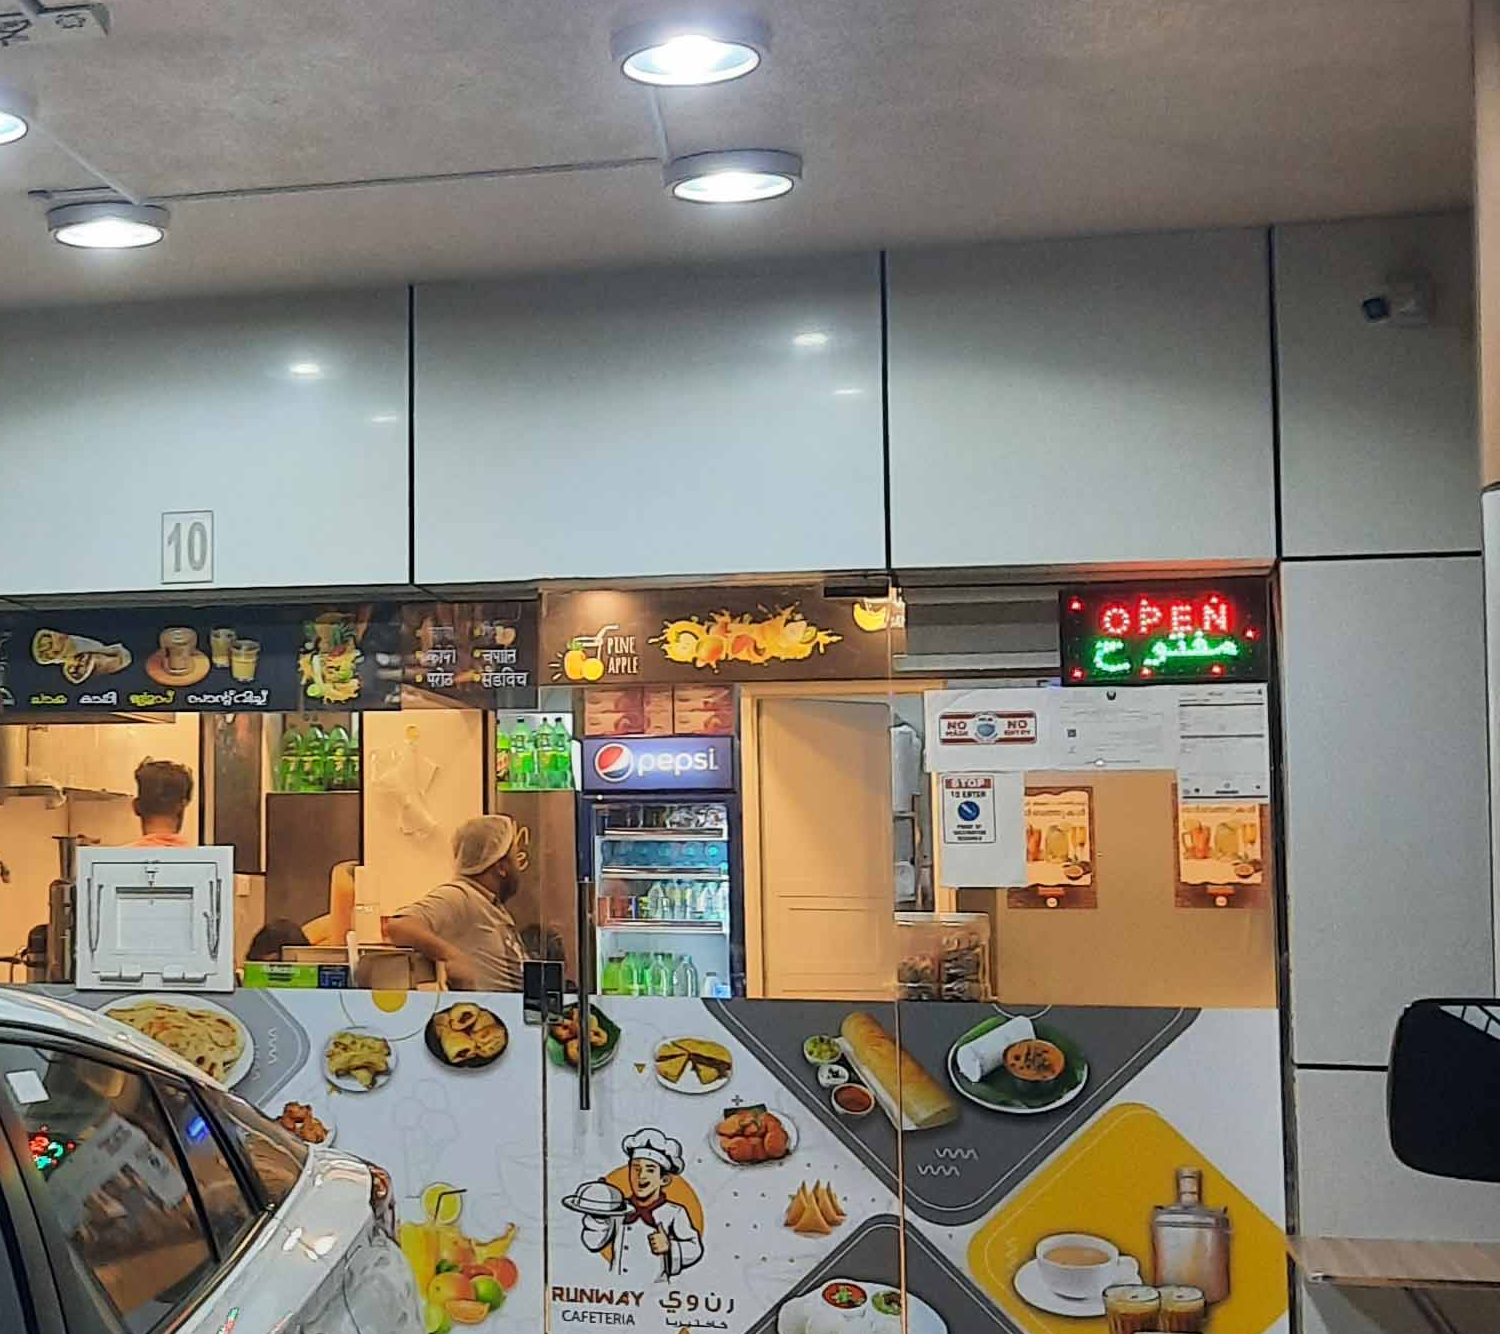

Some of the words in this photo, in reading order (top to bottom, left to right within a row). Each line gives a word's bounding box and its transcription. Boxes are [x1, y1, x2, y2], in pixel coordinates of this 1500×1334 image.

[167, 521, 208, 573] 10
[1103, 599, 1229, 635] OPEN
[607, 635, 636, 654] PINE
[607, 656, 638, 675] APPLE
[947, 721, 967, 730] NO
[1007, 719, 1028, 729] NO
[637, 747, 719, 775] pepsi
[951, 778, 987, 788] STOP
[551, 1286, 644, 1307] RUNWAY
[562, 1309, 636, 1326] CAFETERIA
